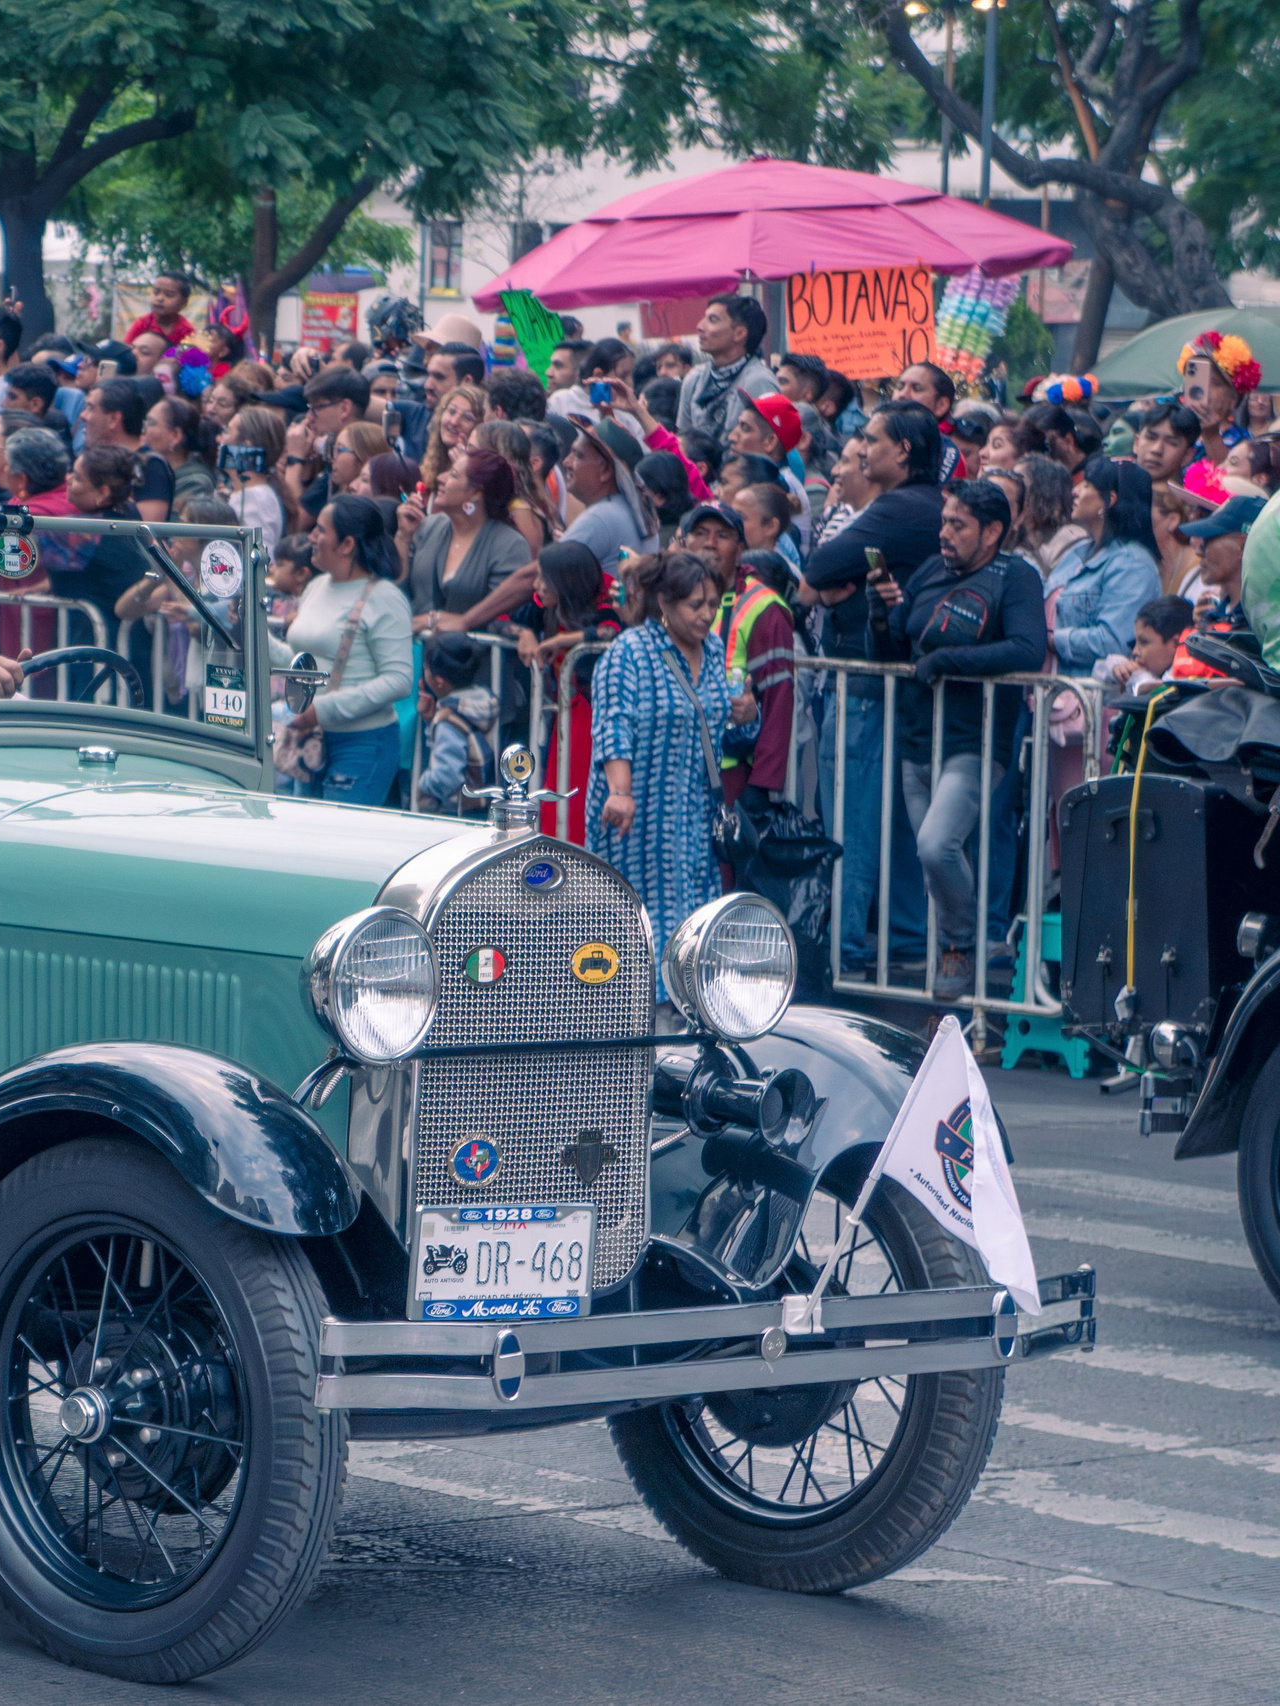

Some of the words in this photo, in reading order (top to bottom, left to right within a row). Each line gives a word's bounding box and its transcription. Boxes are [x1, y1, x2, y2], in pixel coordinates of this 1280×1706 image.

[787, 269, 929, 334] BOTANAS
[211, 692, 242, 713] 140
[207, 715, 243, 727] CONCURSO
[525, 865, 549, 878] Ford
[943, 1158, 959, 1192] ANTIGUOS
[913, 1171, 949, 1212] Autoridad
[485, 1208, 533, 1221] 1928
[476, 1241, 584, 1287] DR-468
[429, 1303, 453, 1316] Ford
[462, 1300, 518, 1318] Model
[550, 1301, 573, 1314] Ford
